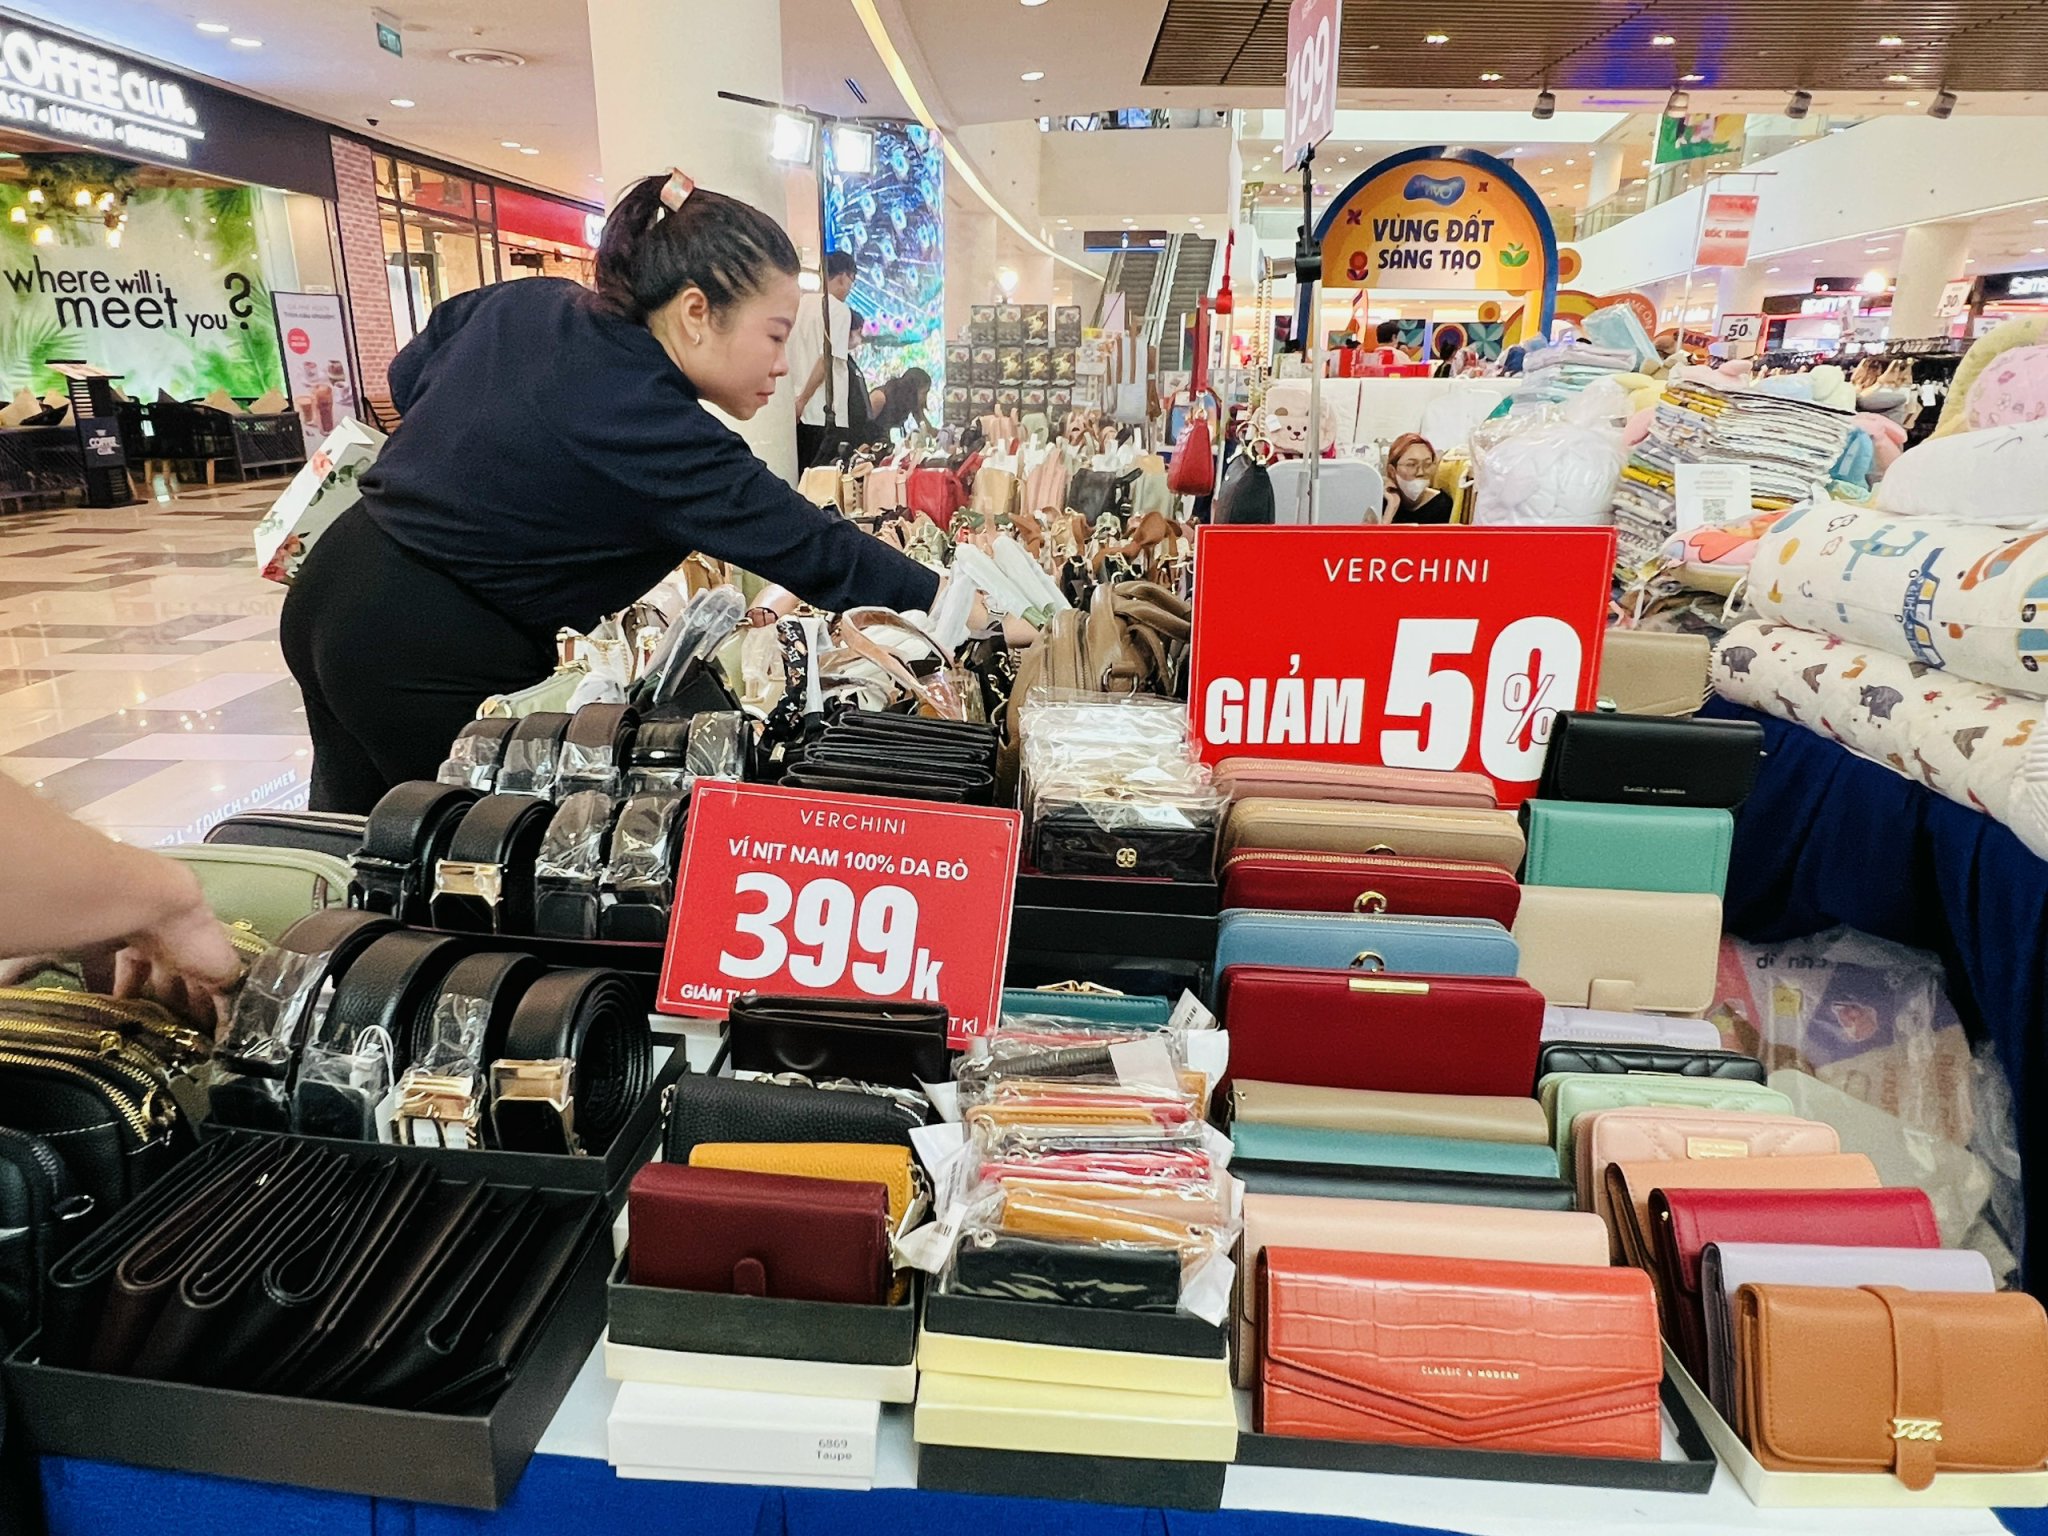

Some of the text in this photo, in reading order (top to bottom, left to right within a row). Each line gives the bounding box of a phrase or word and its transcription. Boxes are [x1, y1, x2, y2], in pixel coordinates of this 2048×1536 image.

[0, 30, 124, 110] OFFEE
[1289, 15, 1330, 146] 199
[1373, 209, 1495, 242] VÙNG ĐẤT
[4, 255, 110, 293] where
[116, 269, 152, 294] will
[1378, 245, 1481, 275] SÁNG TẠO
[55, 288, 178, 329] meet
[185, 313, 228, 337] you
[1323, 558, 1490, 583] VERCHINI
[1204, 654, 1366, 745] GIẢM
[800, 808, 907, 835] VERCHINI
[729, 836, 969, 882] VÍ NỊT NAM 100% DA BÒ
[680, 983, 723, 1003] GIẢM
[1421, 1365, 1462, 1377] CLASSIC
[1477, 1370, 1521, 1380] MODERN
[816, 1450, 853, 1461] Taupe
[818, 1439, 848, 1449] 6869
